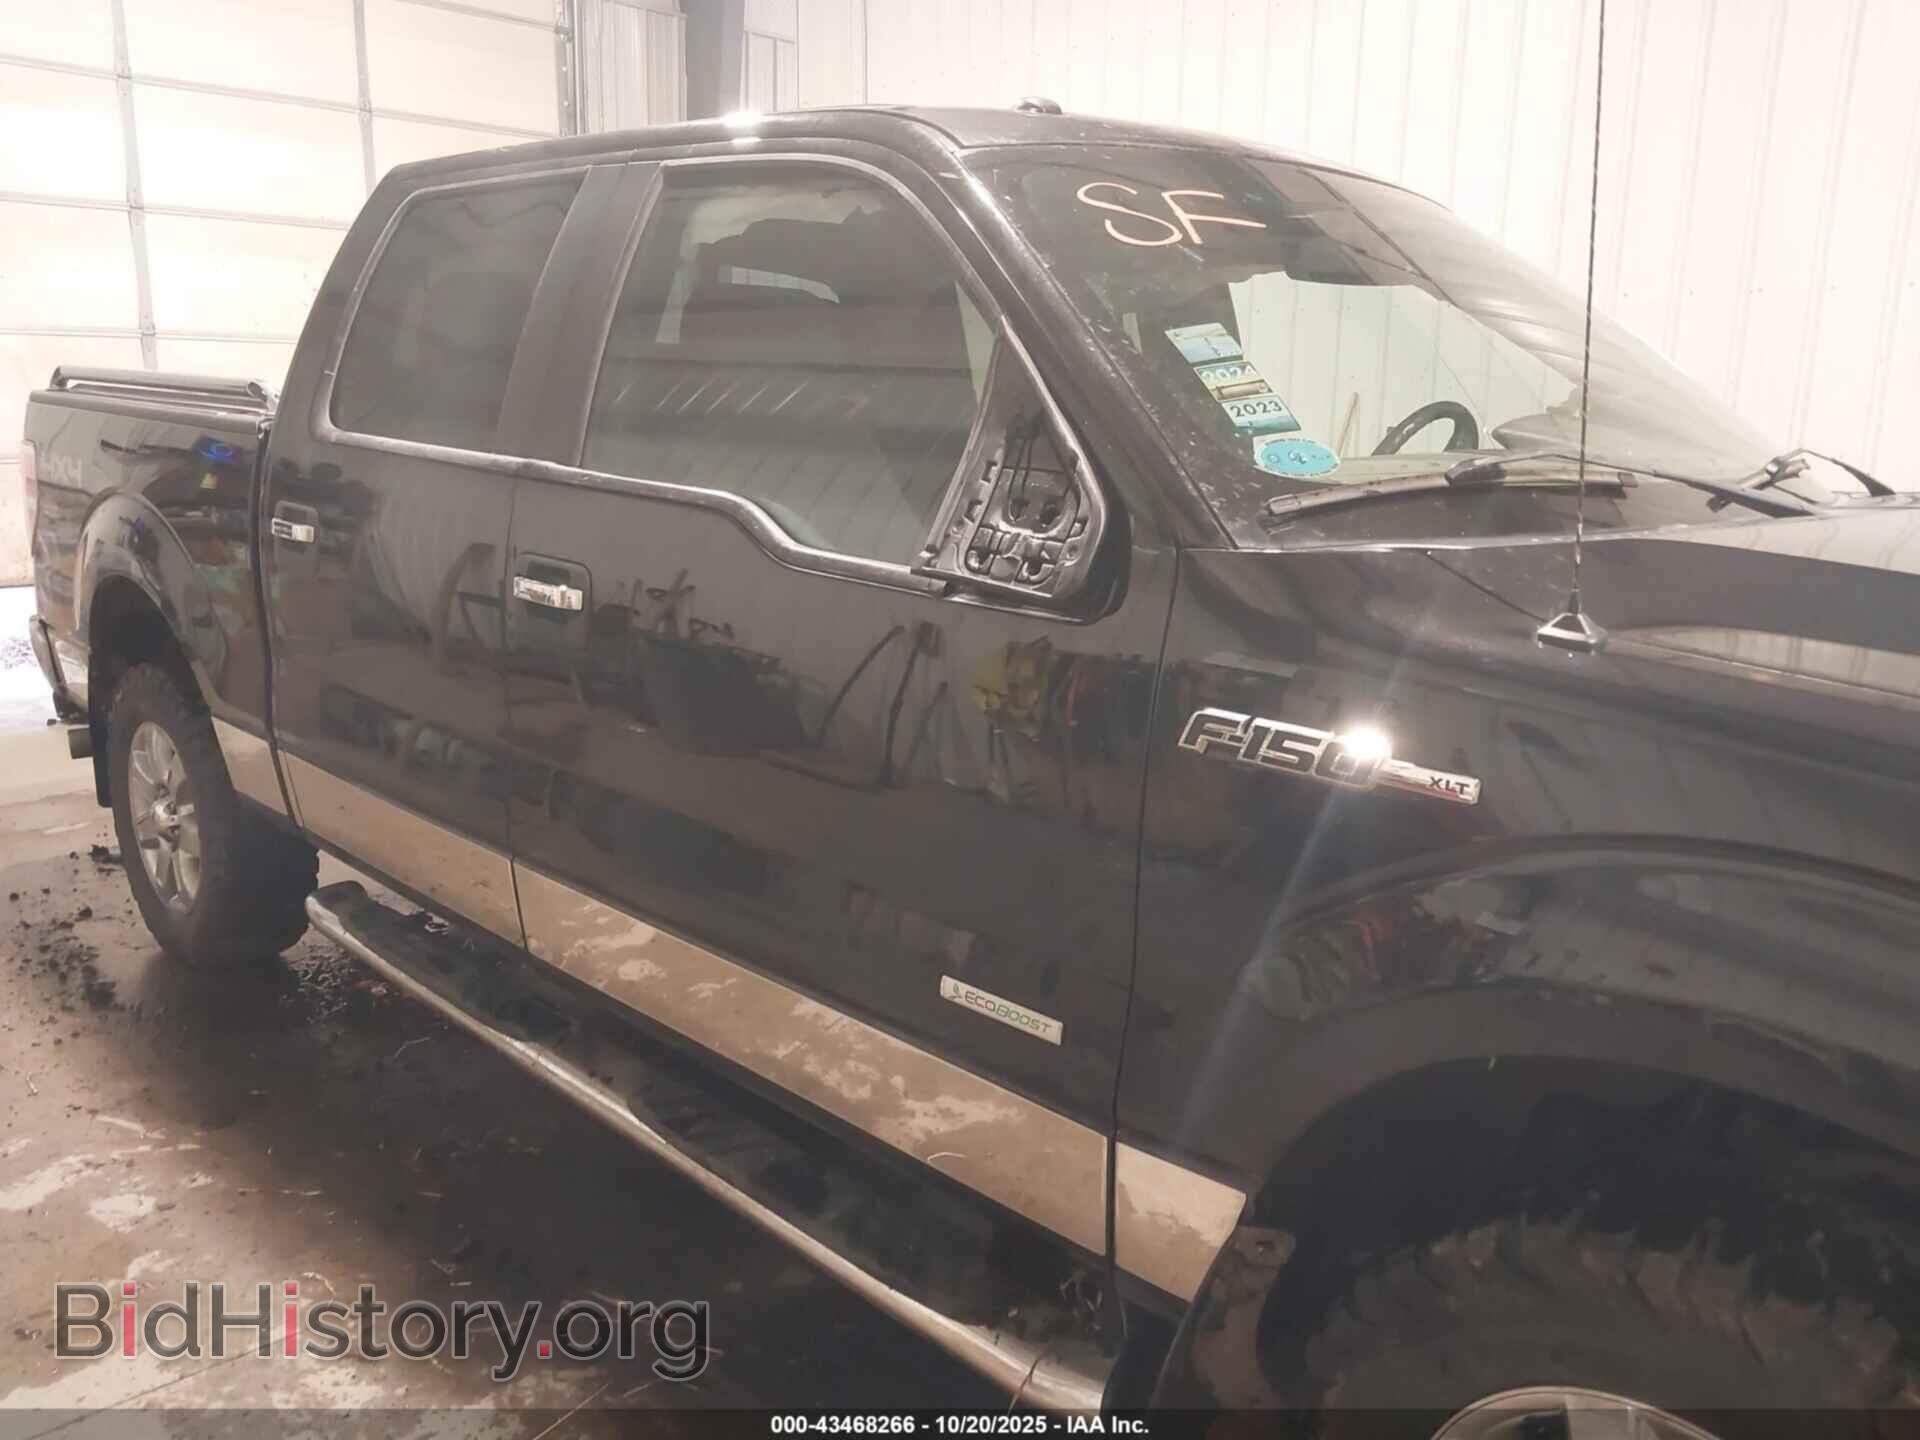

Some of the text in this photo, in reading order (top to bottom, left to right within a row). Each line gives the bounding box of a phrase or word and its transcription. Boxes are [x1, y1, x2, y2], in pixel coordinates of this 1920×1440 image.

[1076, 181, 1267, 247] SF
[1229, 400, 1283, 418] 2023
[1429, 775, 1471, 796] XLT
[964, 990, 1052, 1034] ECOBOOST
